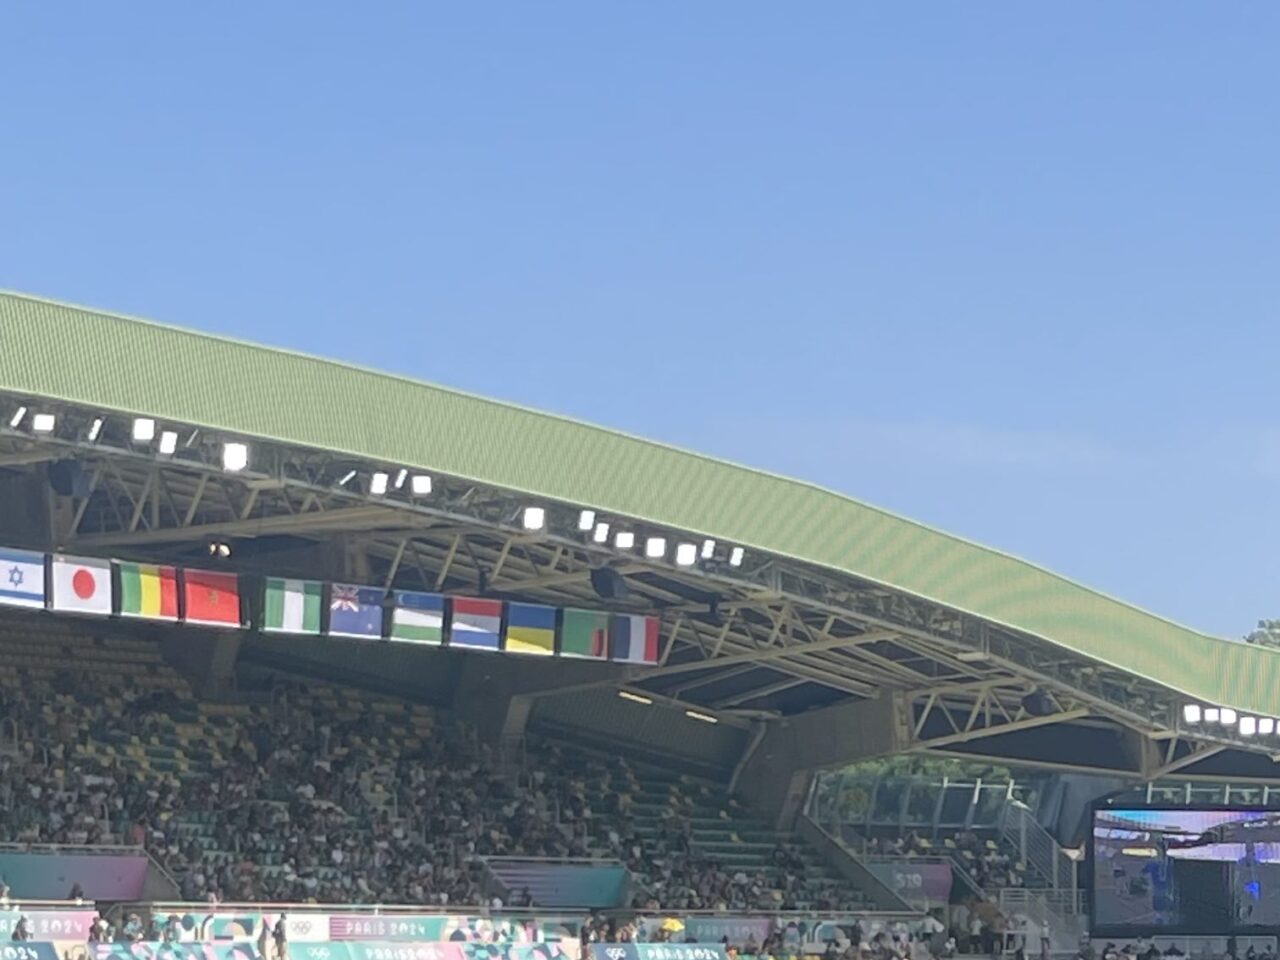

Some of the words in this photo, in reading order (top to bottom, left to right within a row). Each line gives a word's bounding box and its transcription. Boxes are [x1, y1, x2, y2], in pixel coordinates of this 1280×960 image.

[41, 919, 83, 934] 2024
[346, 921, 385, 935] PARIS
[390, 922, 426, 936] 2024
[0, 946, 39, 960] 024
